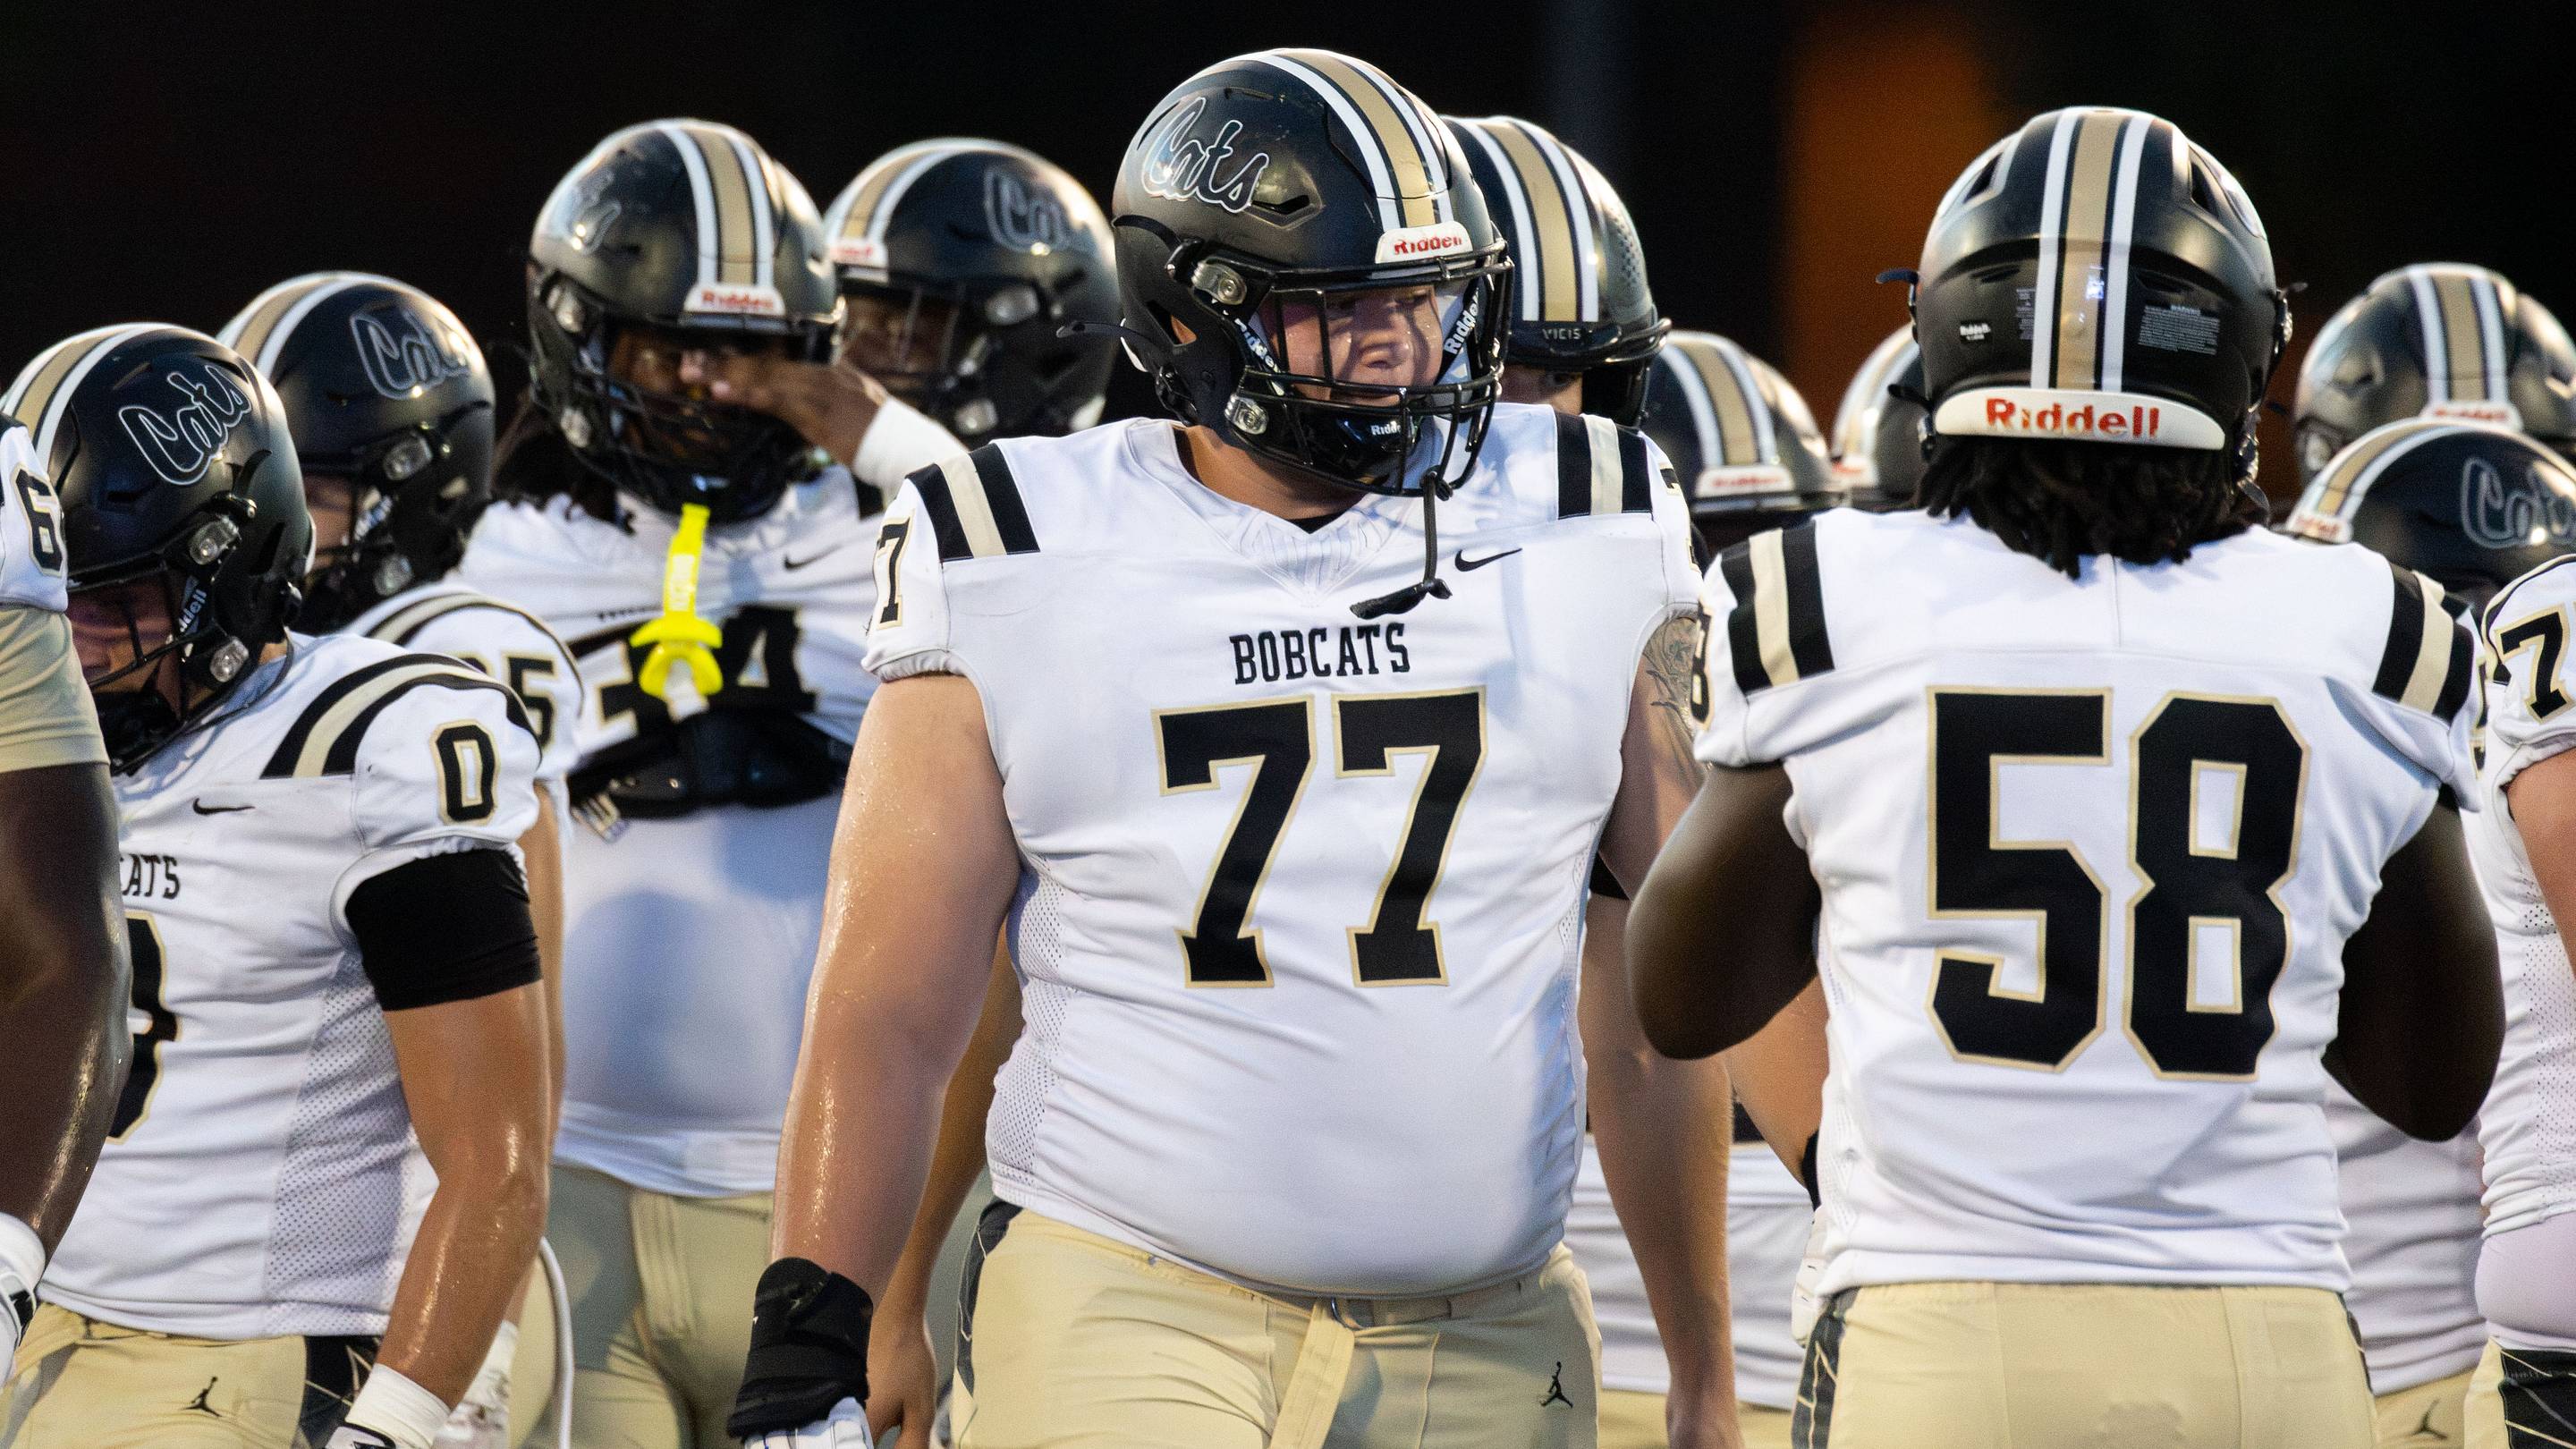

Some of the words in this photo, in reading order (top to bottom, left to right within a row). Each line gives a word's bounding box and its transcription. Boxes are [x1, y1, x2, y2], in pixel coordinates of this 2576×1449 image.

[1142, 96, 1270, 214] Cats
[1542, 327, 1581, 340] VICIS
[119, 364, 252, 486] Cats
[1986, 397, 2160, 438] Riddell
[1229, 623, 1411, 685] BOBCATS
[2494, 601, 2576, 725] 7
[429, 718, 501, 826] 0
[1151, 685, 1487, 989] 77
[1926, 686, 2310, 1081] 58
